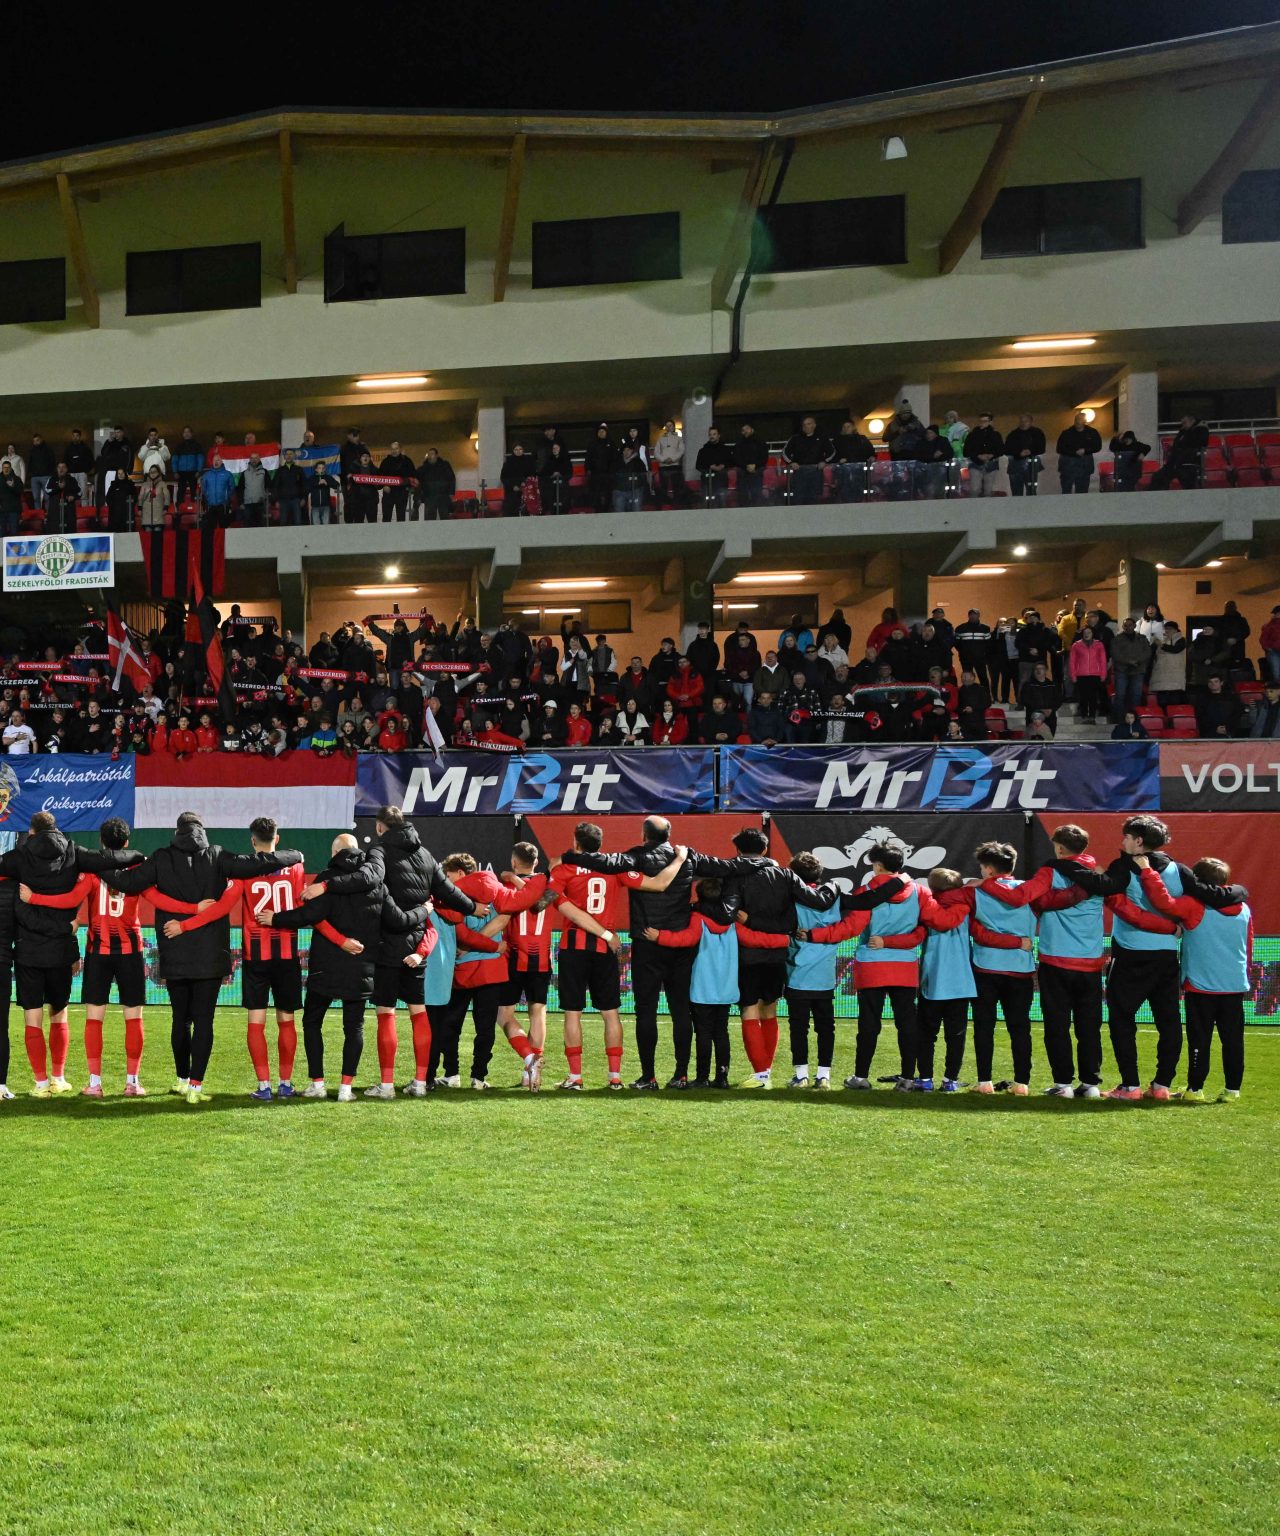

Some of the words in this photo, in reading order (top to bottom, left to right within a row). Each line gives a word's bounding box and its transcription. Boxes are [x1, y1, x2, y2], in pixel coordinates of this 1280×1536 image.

[24, 765, 132, 787] Lokálpatrióták
[401, 754, 621, 813] MrBit
[814, 747, 1058, 809] MrBit
[41, 795, 113, 814] Csíkszereda
[251, 880, 294, 919] 20
[586, 877, 607, 915] 8
